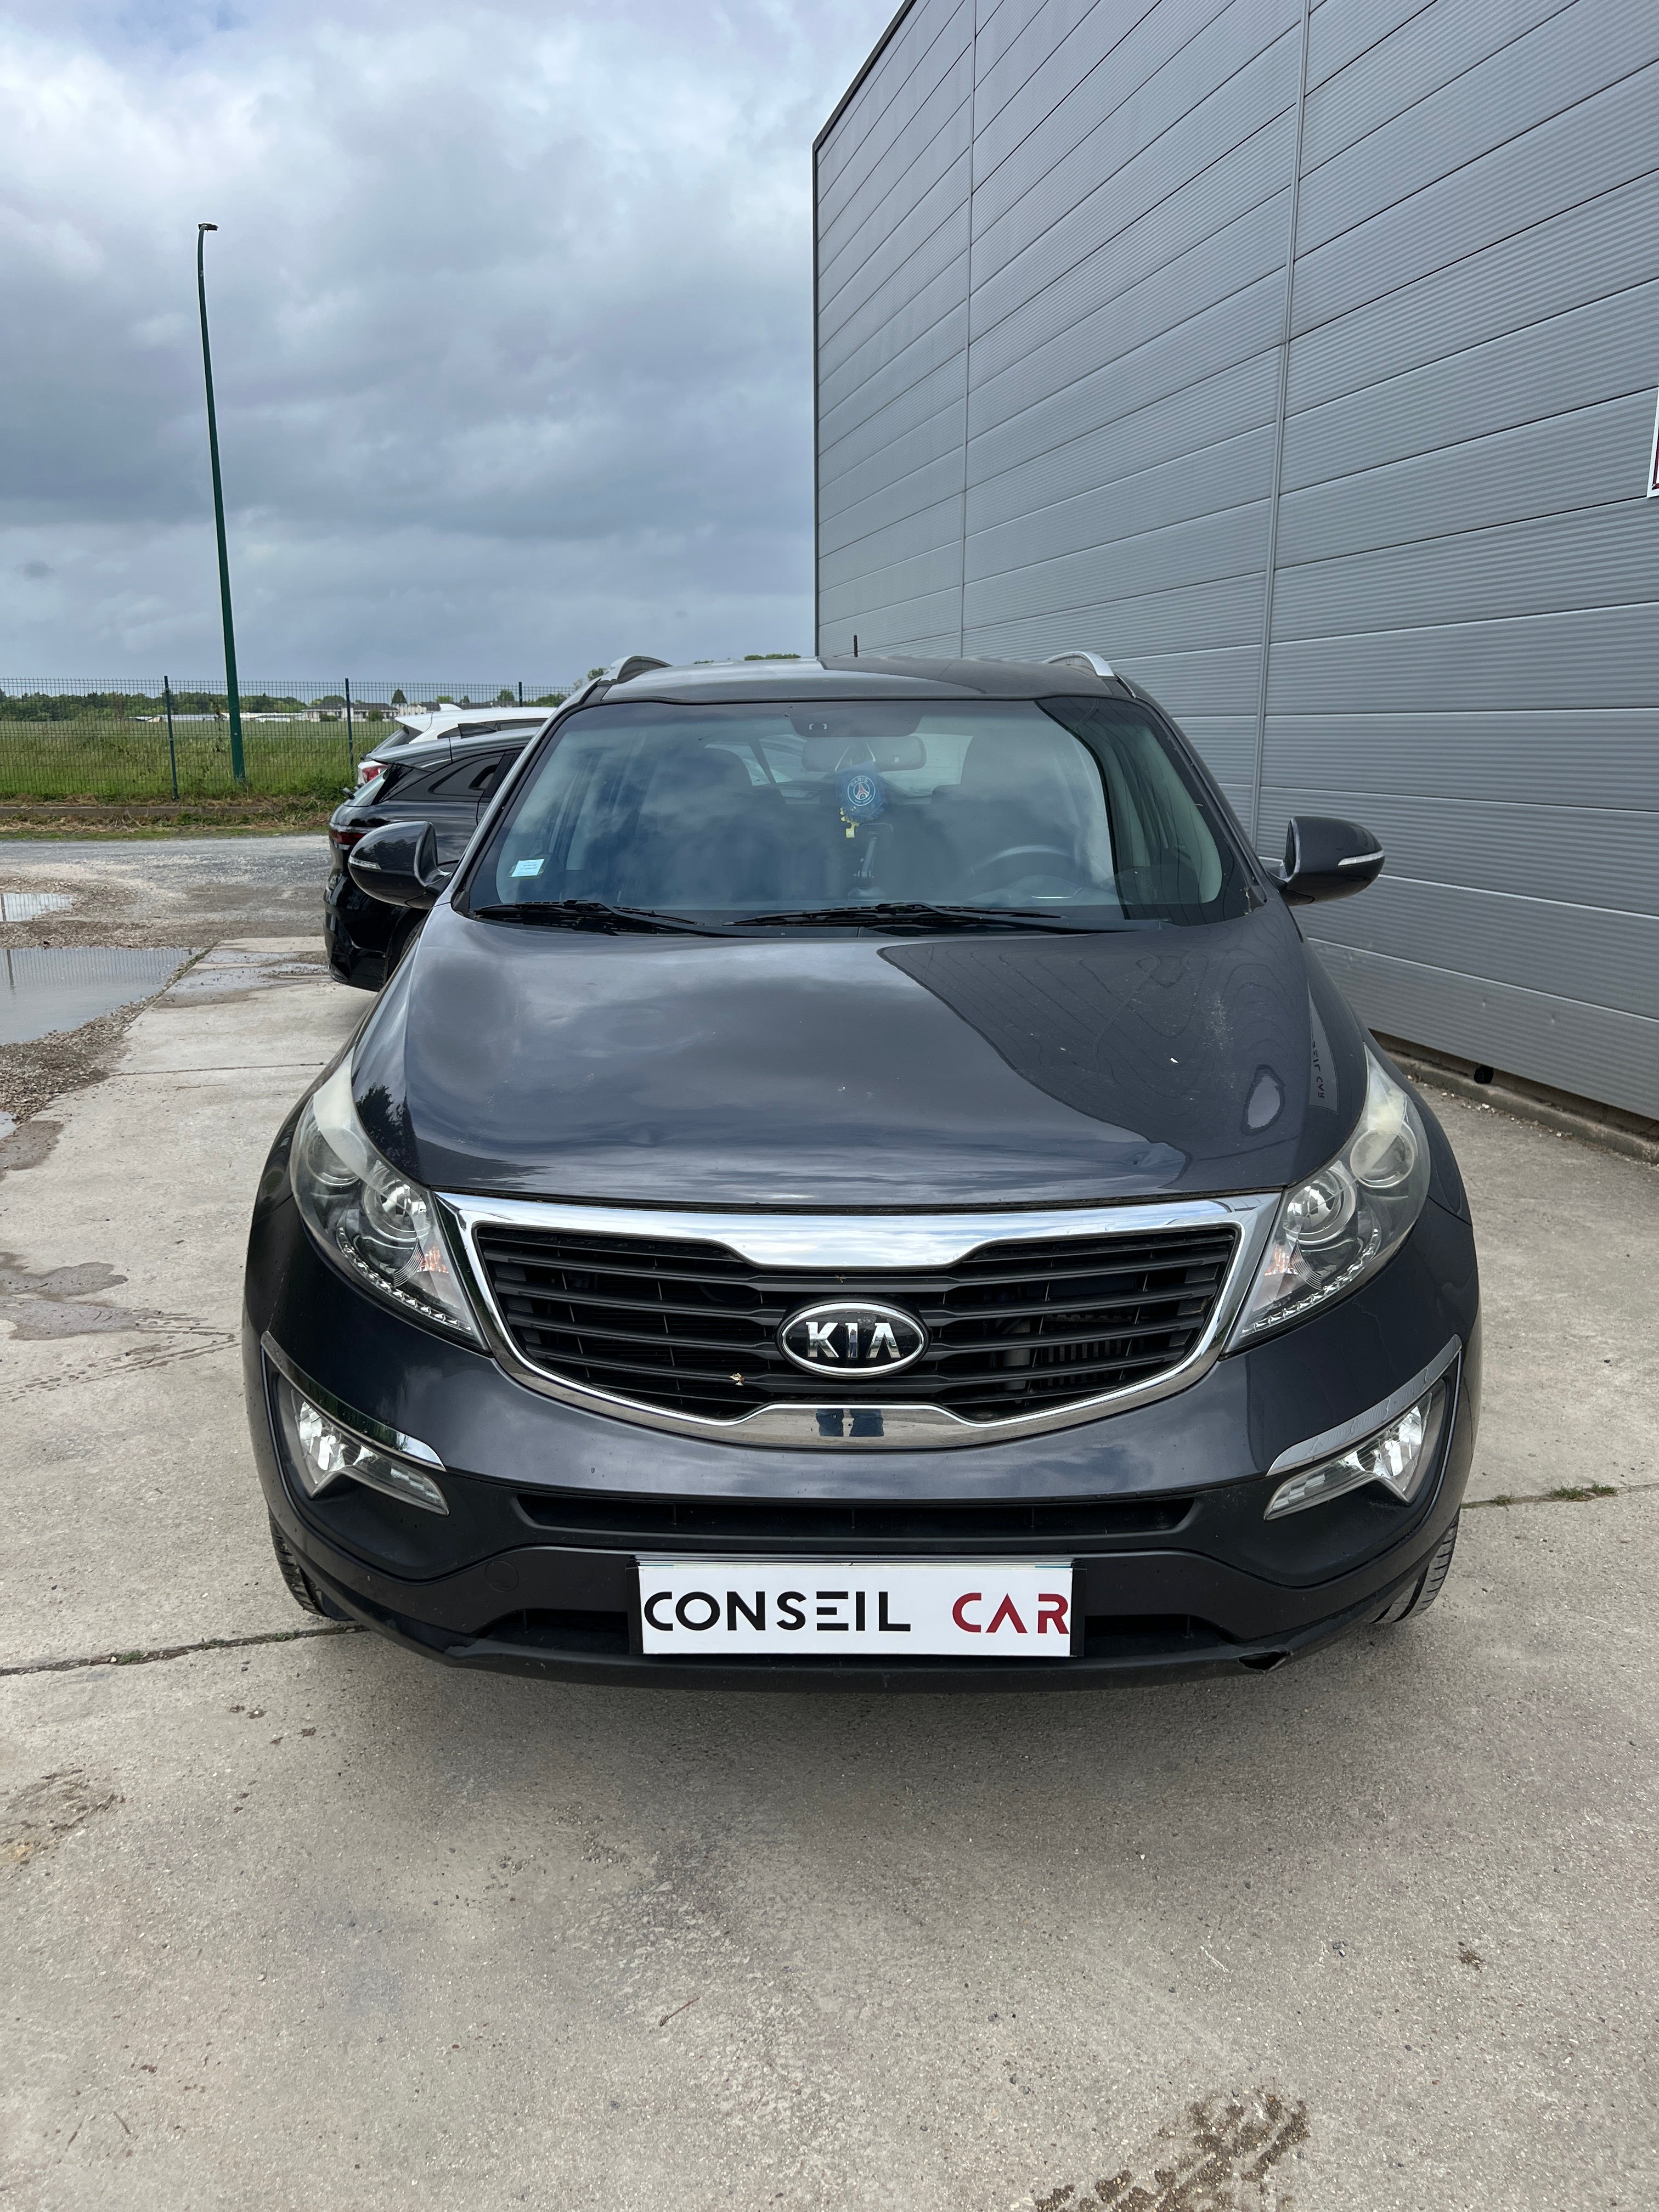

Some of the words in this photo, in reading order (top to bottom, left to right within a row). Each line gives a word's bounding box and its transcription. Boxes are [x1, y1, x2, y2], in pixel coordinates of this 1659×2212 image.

[850, 777, 868, 787] PARIS
[805, 1322, 901, 1358] KIA
[644, 1591, 911, 1632] CONSEIL
[952, 1592, 1070, 1634] CAR
